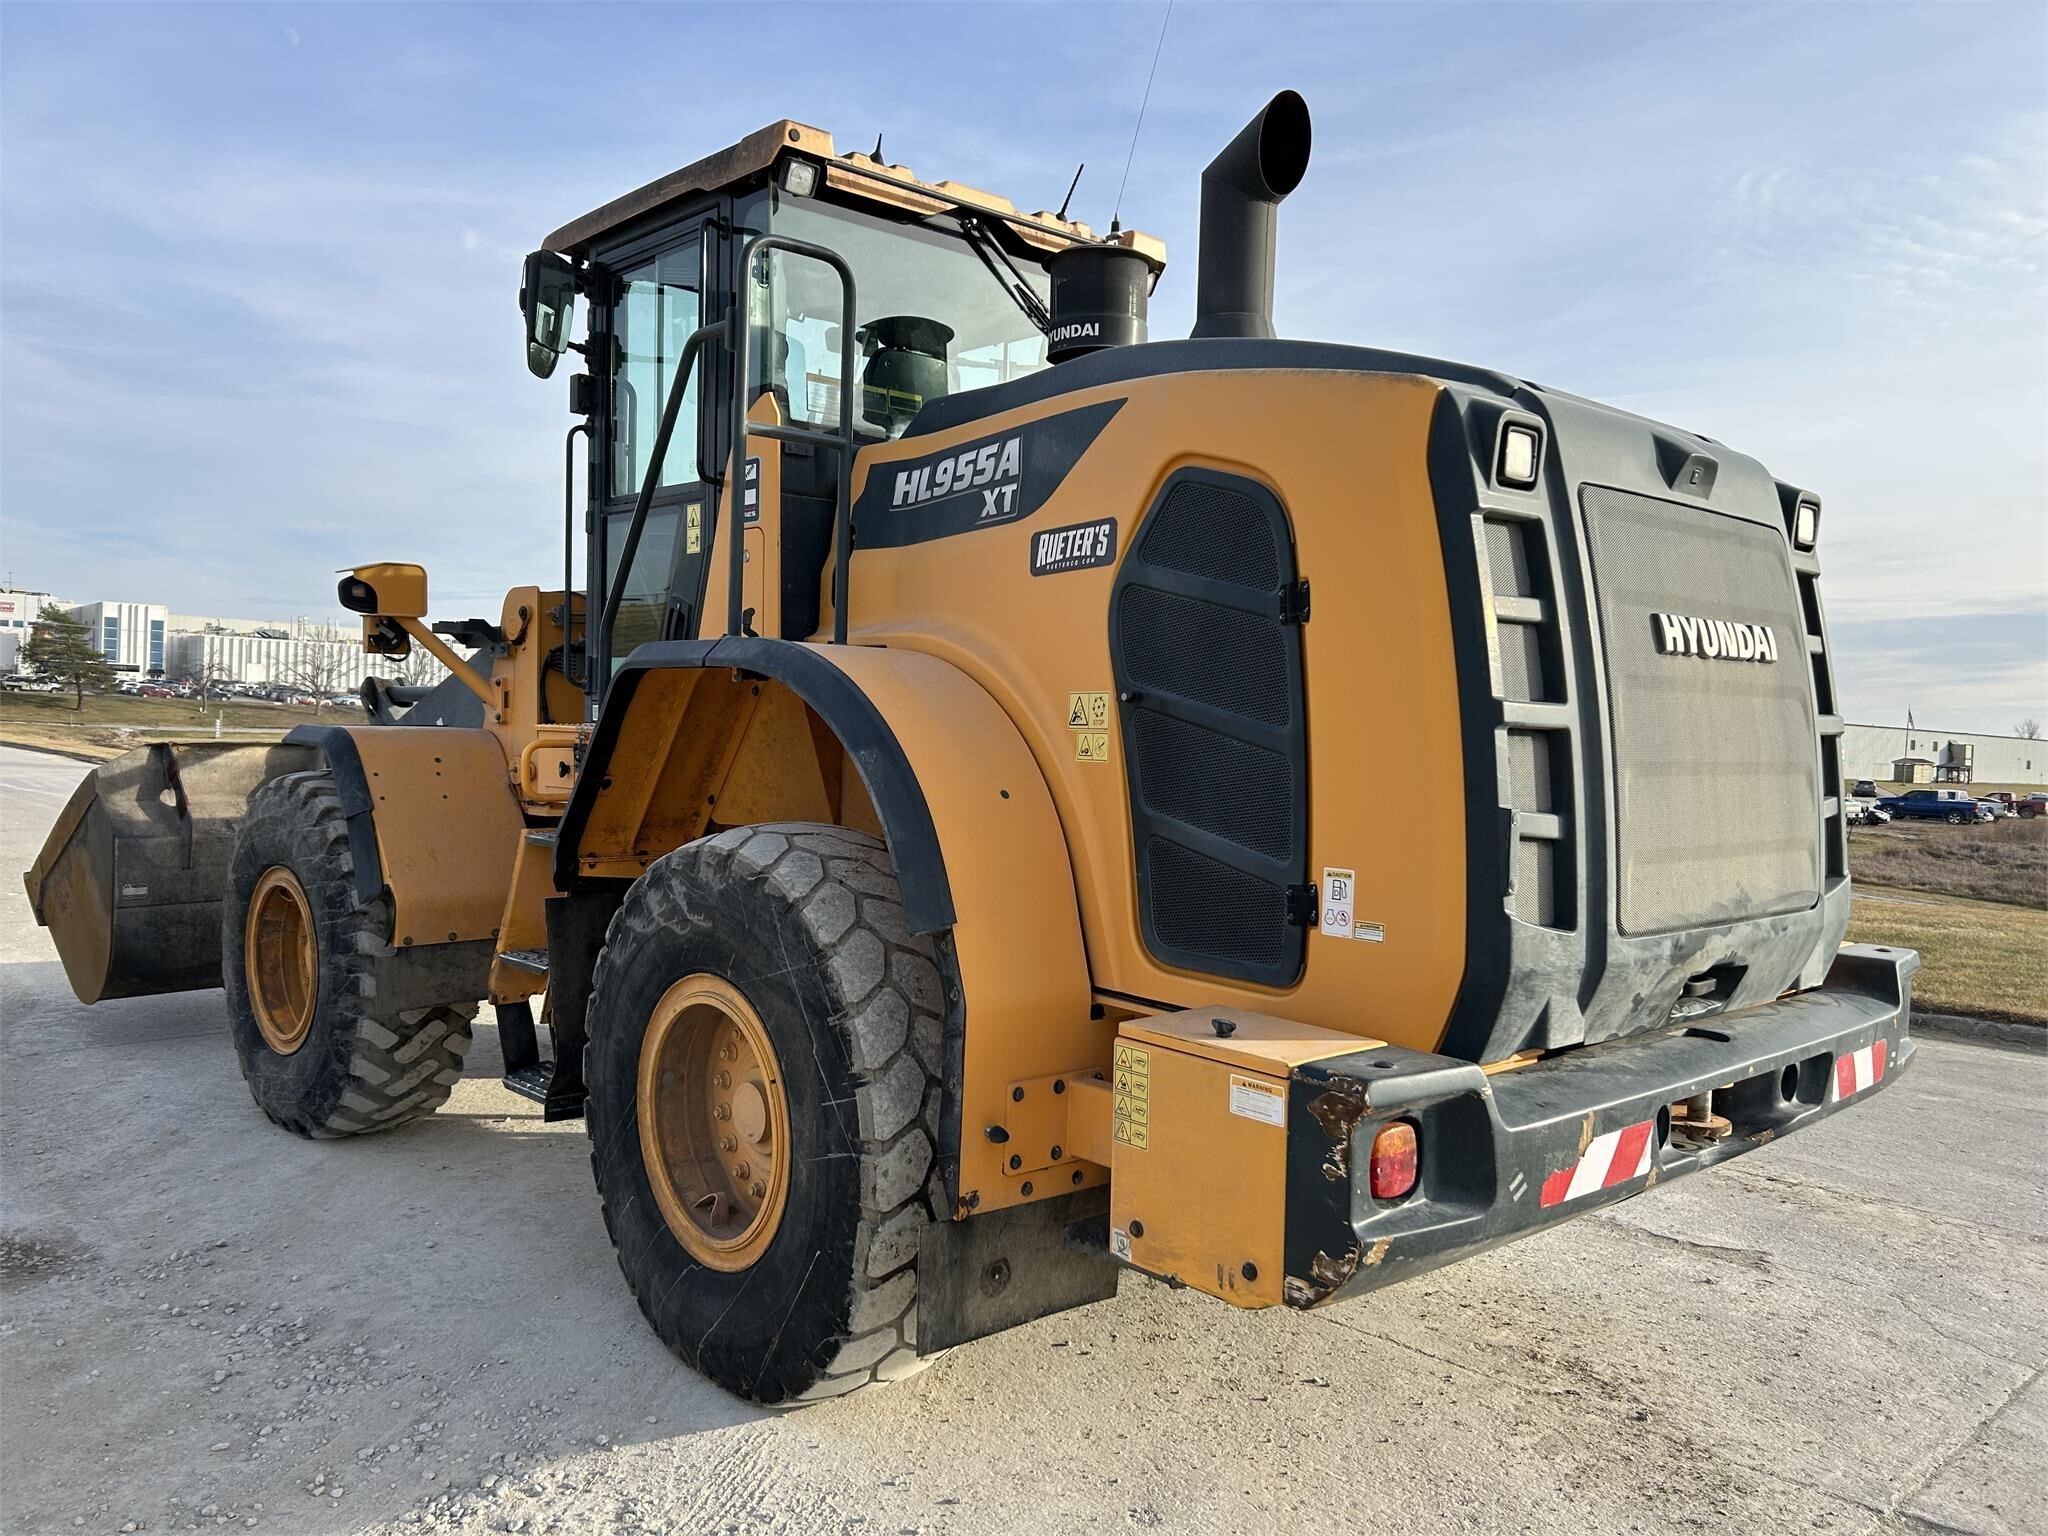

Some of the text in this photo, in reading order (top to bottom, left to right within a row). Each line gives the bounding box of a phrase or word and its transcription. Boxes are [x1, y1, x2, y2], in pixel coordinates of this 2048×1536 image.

[1049, 322, 1100, 344] YUNDAI
[892, 437, 1020, 506] HL955A
[980, 482, 1018, 518] XT
[1036, 524, 1110, 568] RUETER'S
[1657, 613, 1778, 662] HYUNDAI
[1248, 1082, 1273, 1092] WARNING
